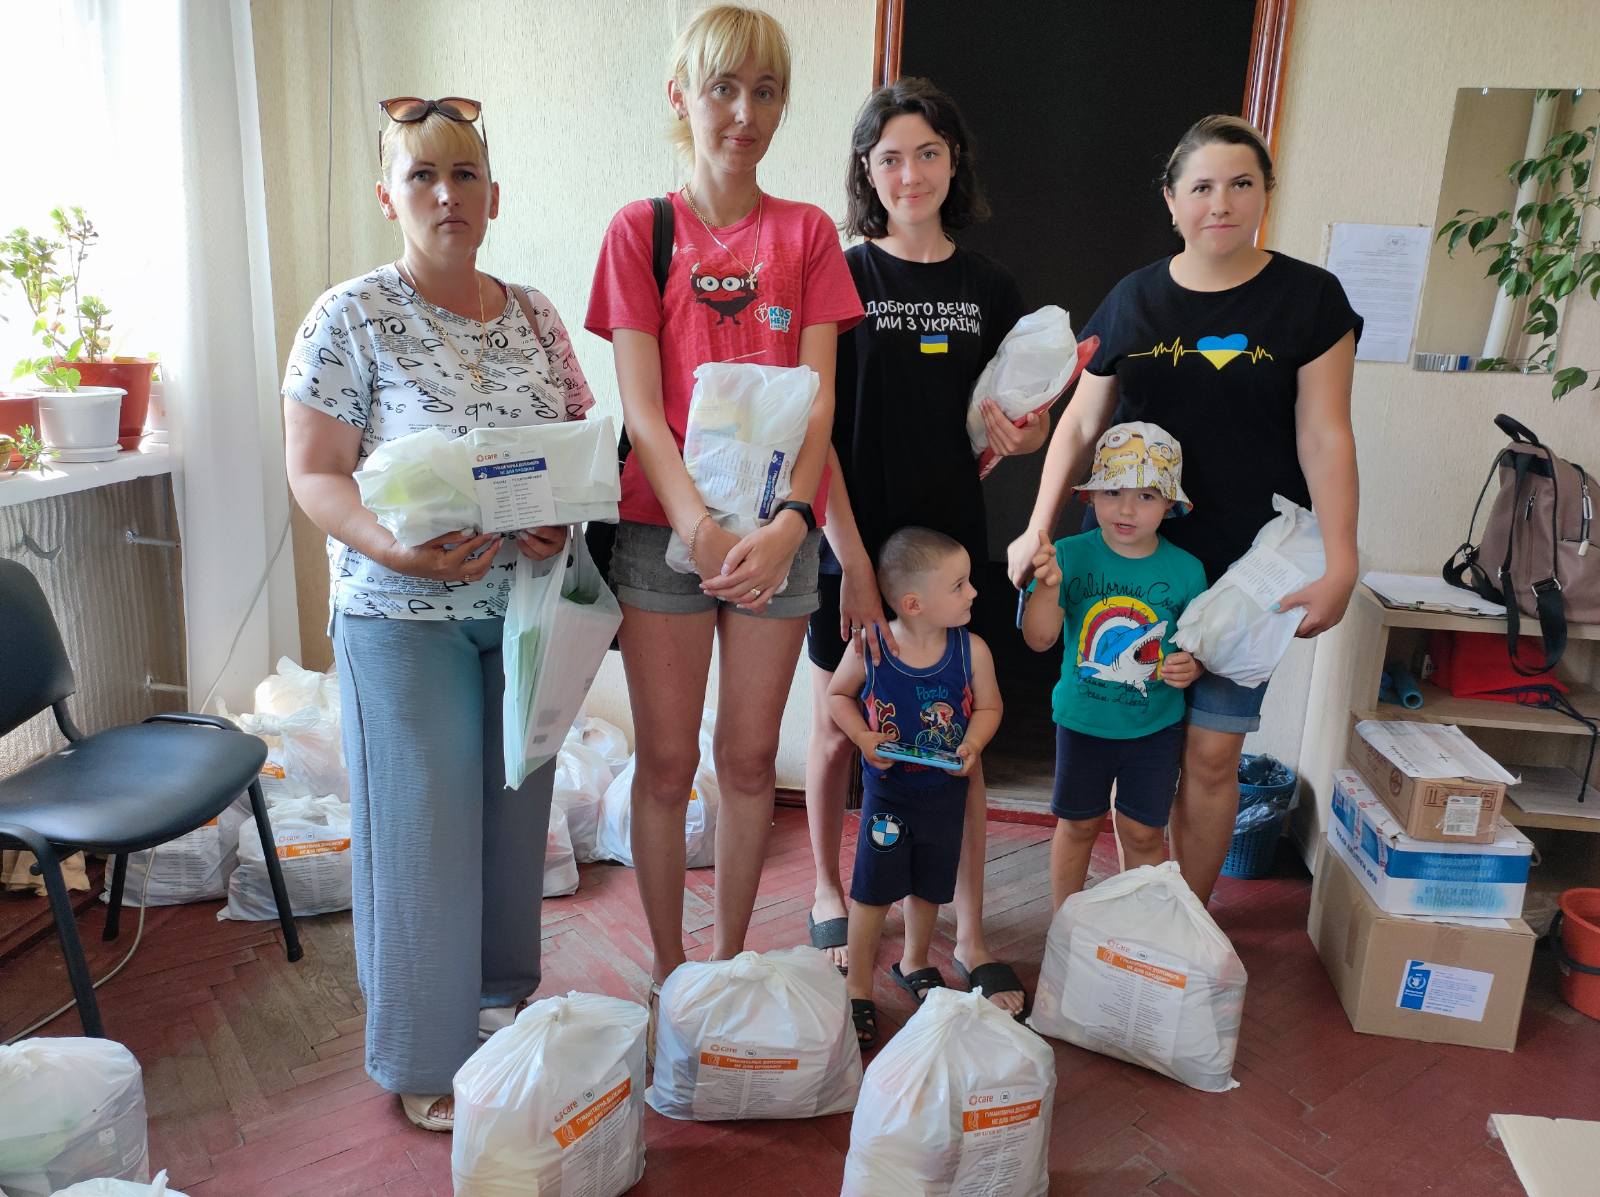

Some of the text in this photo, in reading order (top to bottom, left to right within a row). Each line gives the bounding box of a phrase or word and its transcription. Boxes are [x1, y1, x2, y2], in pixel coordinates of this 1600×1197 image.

[865, 300, 933, 318] ДОБРОГО
[876, 314, 980, 336] МИ З УКРАЇНИ
[1066, 572, 1145, 605] California
